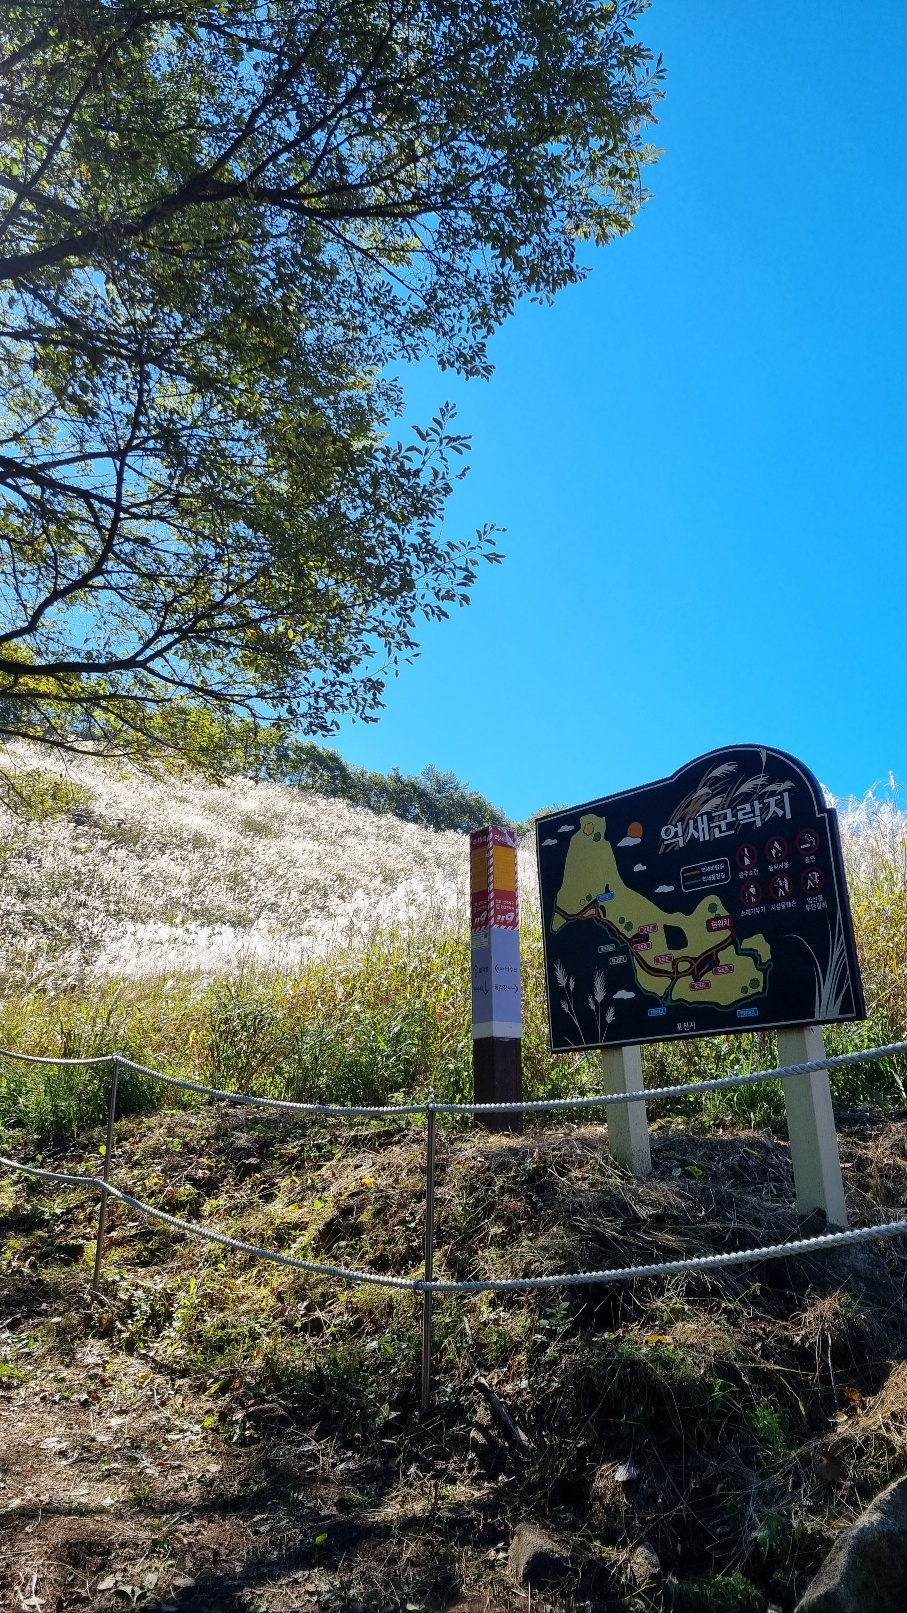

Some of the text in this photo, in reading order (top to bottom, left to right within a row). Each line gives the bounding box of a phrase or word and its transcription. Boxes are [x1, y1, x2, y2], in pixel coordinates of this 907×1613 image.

[660, 791, 791, 847] 억새군락지
[738, 868, 759, 879] 음주소란
[740, 906, 766, 917] 쓰레기투기
[770, 900, 797, 912] 시설물훼손
[711, 917, 730, 930] 현위치
[676, 1020, 696, 1032] 포천시
